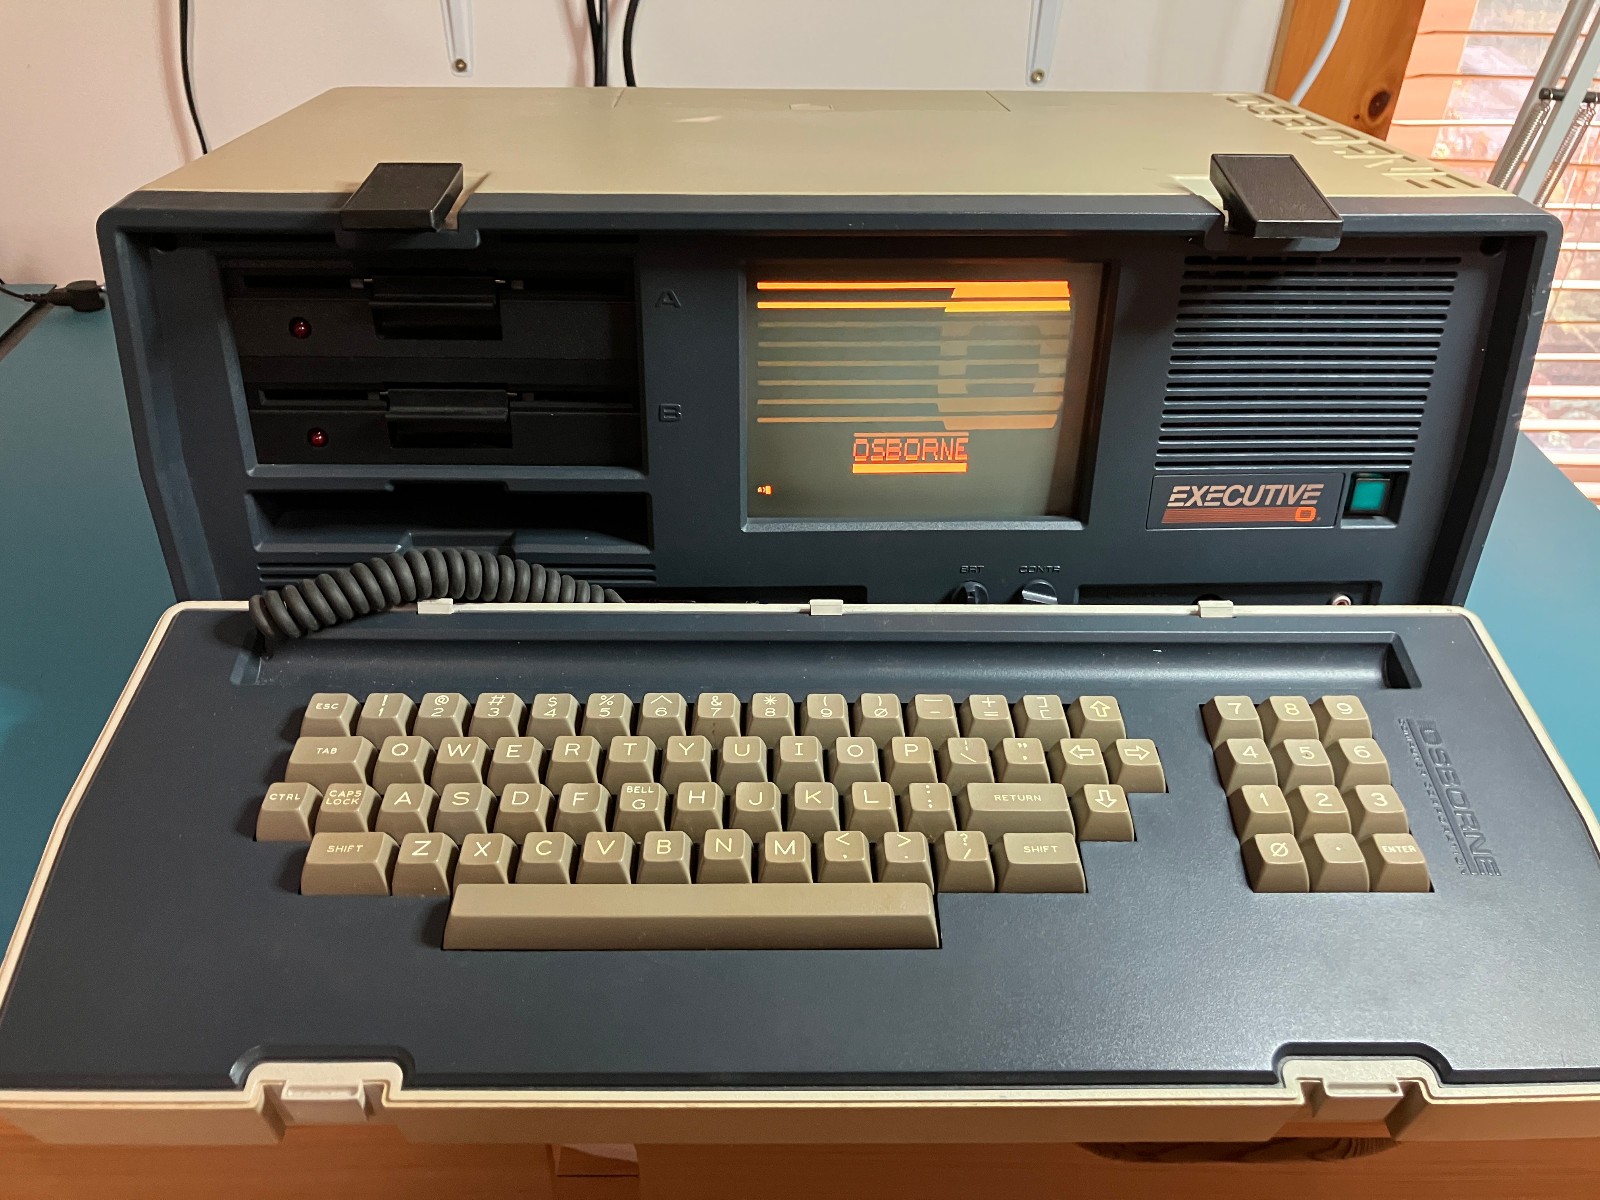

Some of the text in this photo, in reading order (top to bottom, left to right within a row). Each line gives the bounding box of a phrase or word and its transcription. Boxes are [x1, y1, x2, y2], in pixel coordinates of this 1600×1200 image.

[655, 289, 682, 308] A
[658, 403, 682, 422] B
[852, 438, 969, 462] OSBORNE
[1167, 484, 1325, 507] EXECUTIVE
[434, 694, 450, 706] @
[488, 694, 506, 706] #
[548, 695, 558, 707] $
[598, 694, 616, 705] %
[709, 694, 722, 706] &
[315, 702, 339, 710] ESC
[430, 707, 446, 717] 2
[1227, 703, 1241, 714] 7
[1284, 703, 1300, 715] 8
[1337, 703, 1352, 714] 9
[487, 707, 501, 718] 3
[543, 708, 557, 718] 4
[597, 708, 611, 718] 5
[654, 708, 668, 717] 6
[711, 708, 722, 718] 7
[764, 708, 775, 718] 8
[820, 708, 833, 718] 9
[316, 747, 338, 755] TAB
[392, 743, 409, 756] Q
[448, 744, 471, 757] W
[506, 745, 522, 757] E
[565, 743, 580, 755] R
[624, 743, 637, 756] T
[679, 743, 694, 755] Y
[735, 744, 750, 756] U
[795, 743, 803, 755] I
[847, 745, 863, 757] O
[905, 744, 918, 756] P
[1242, 746, 1258, 758] 4
[1299, 747, 1315, 759] 5
[1354, 746, 1371, 758] 6
[328, 790, 363, 798] CAPS
[626, 785, 655, 794] BELL
[269, 793, 301, 801] CTRL
[325, 797, 361, 806] LOCK
[394, 792, 411, 805] A
[452, 792, 470, 805] S
[512, 791, 529, 805] D
[573, 792, 588, 806] F
[689, 790, 705, 804] H
[749, 792, 762, 805] J
[806, 790, 821, 803] K
[864, 790, 879, 803] L
[994, 794, 1042, 802] RETURN
[1315, 793, 1332, 806] 2
[1371, 793, 1388, 806] 3
[632, 799, 645, 811] G
[326, 844, 364, 853] SHIFT
[412, 841, 431, 856] Z
[474, 842, 491, 856] X
[536, 840, 552, 855] C
[597, 840, 615, 855] V
[657, 840, 671, 854] B
[716, 838, 732, 852] N
[775, 840, 795, 855] M
[1023, 845, 1059, 854] SHIFT
[1381, 845, 1416, 854] ENTER
